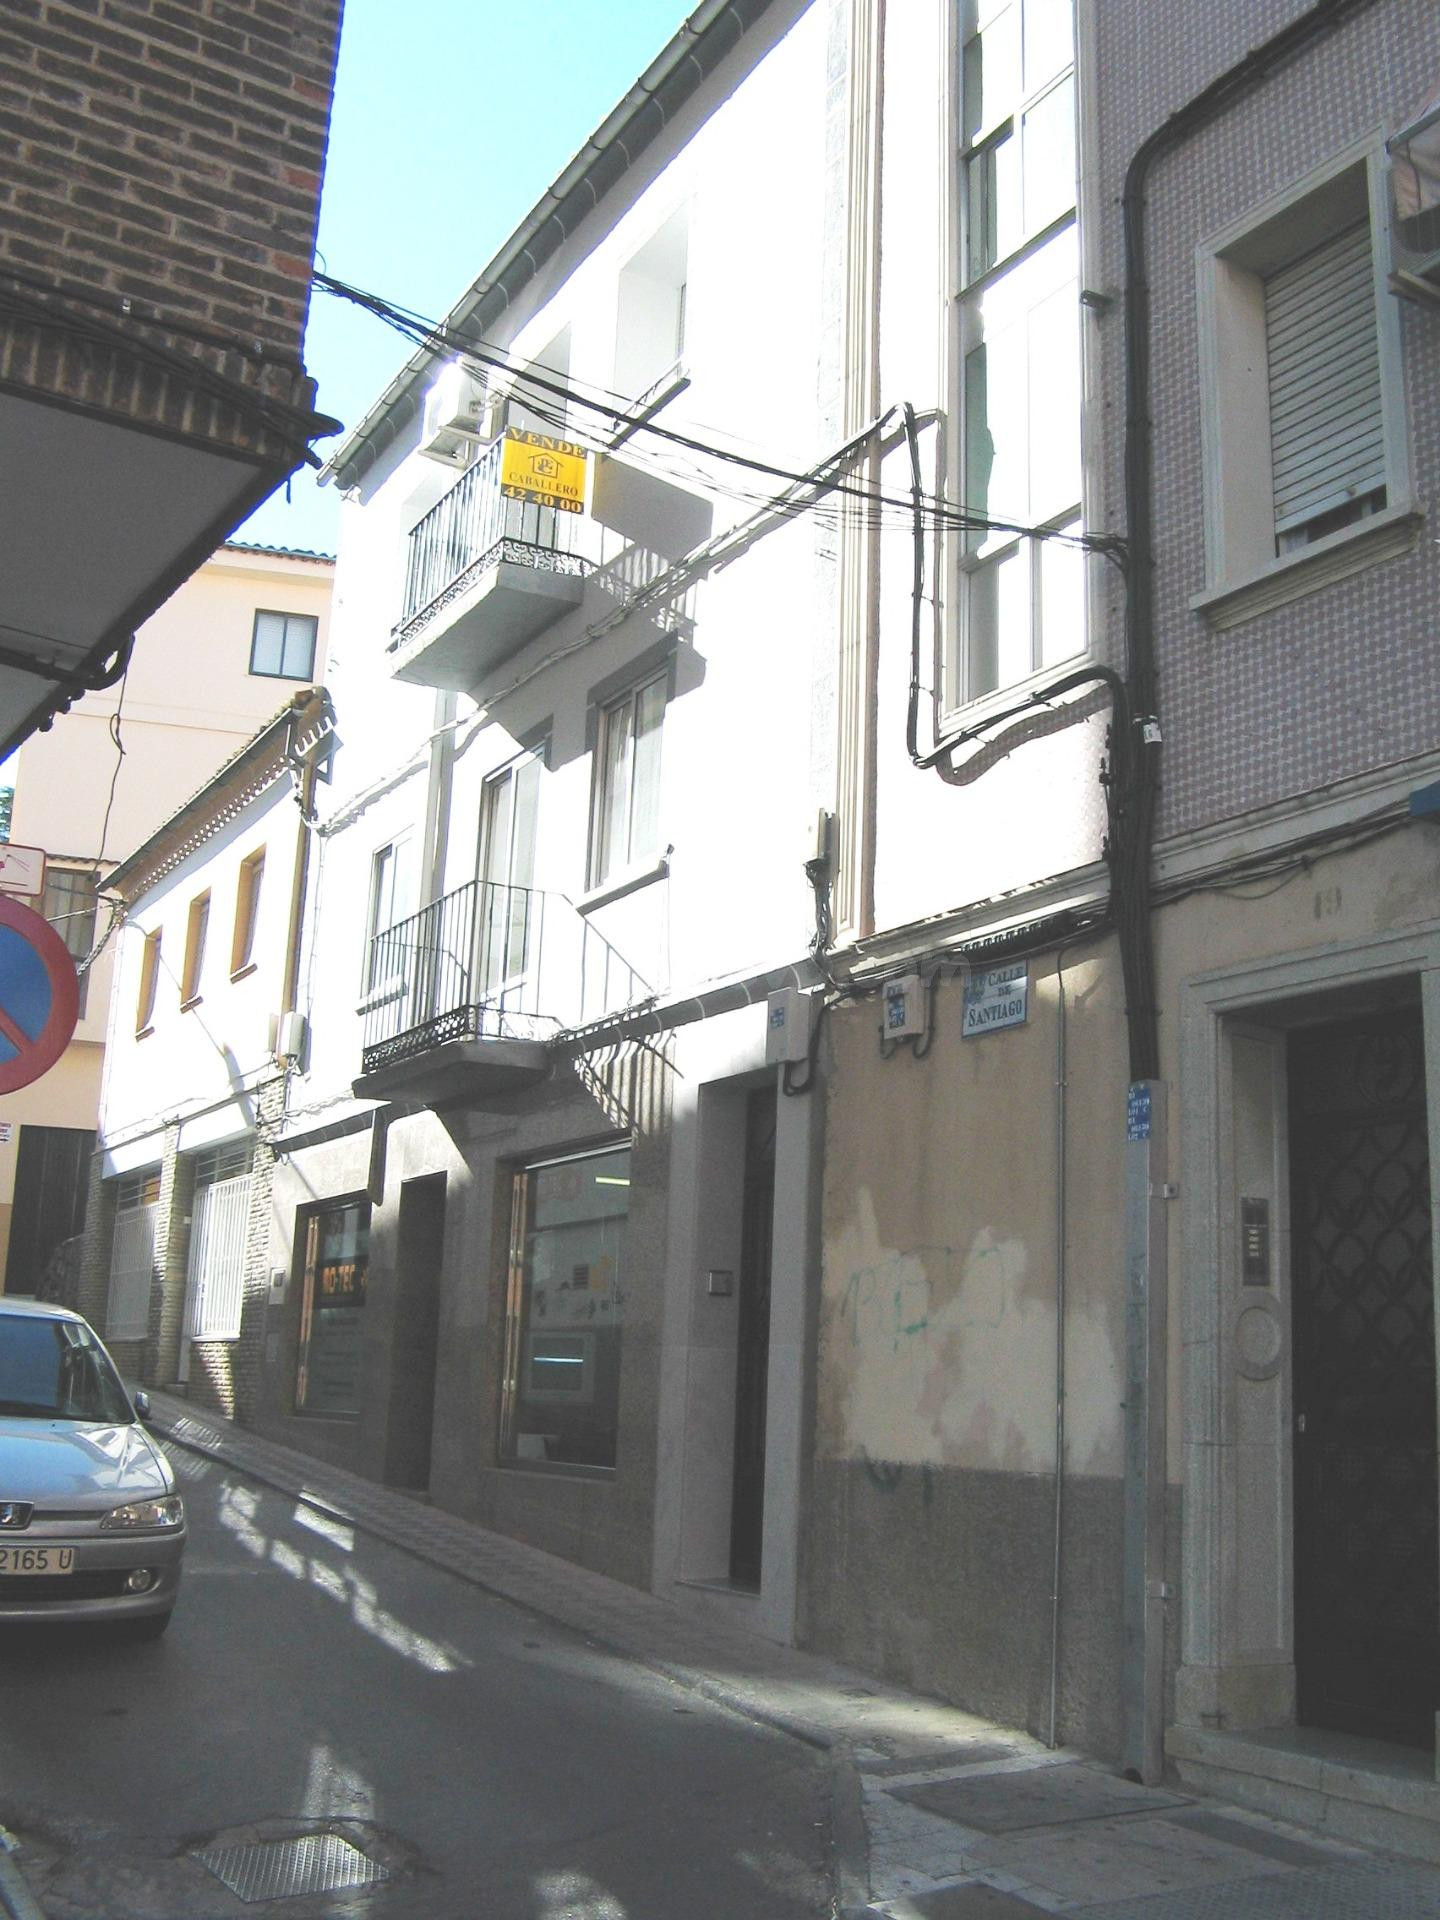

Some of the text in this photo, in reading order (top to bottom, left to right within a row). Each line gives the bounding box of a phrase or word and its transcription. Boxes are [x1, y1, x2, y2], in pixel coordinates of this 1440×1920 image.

[510, 427, 585, 457] VENDE
[509, 471, 578, 498] CABALLERO
[504, 486, 582, 513] 42 40 00
[988, 966, 1024, 986] CALLE
[998, 985, 1012, 997] DE
[969, 999, 1023, 1027] SANTIAGO
[58, 1549, 72, 1570] U
